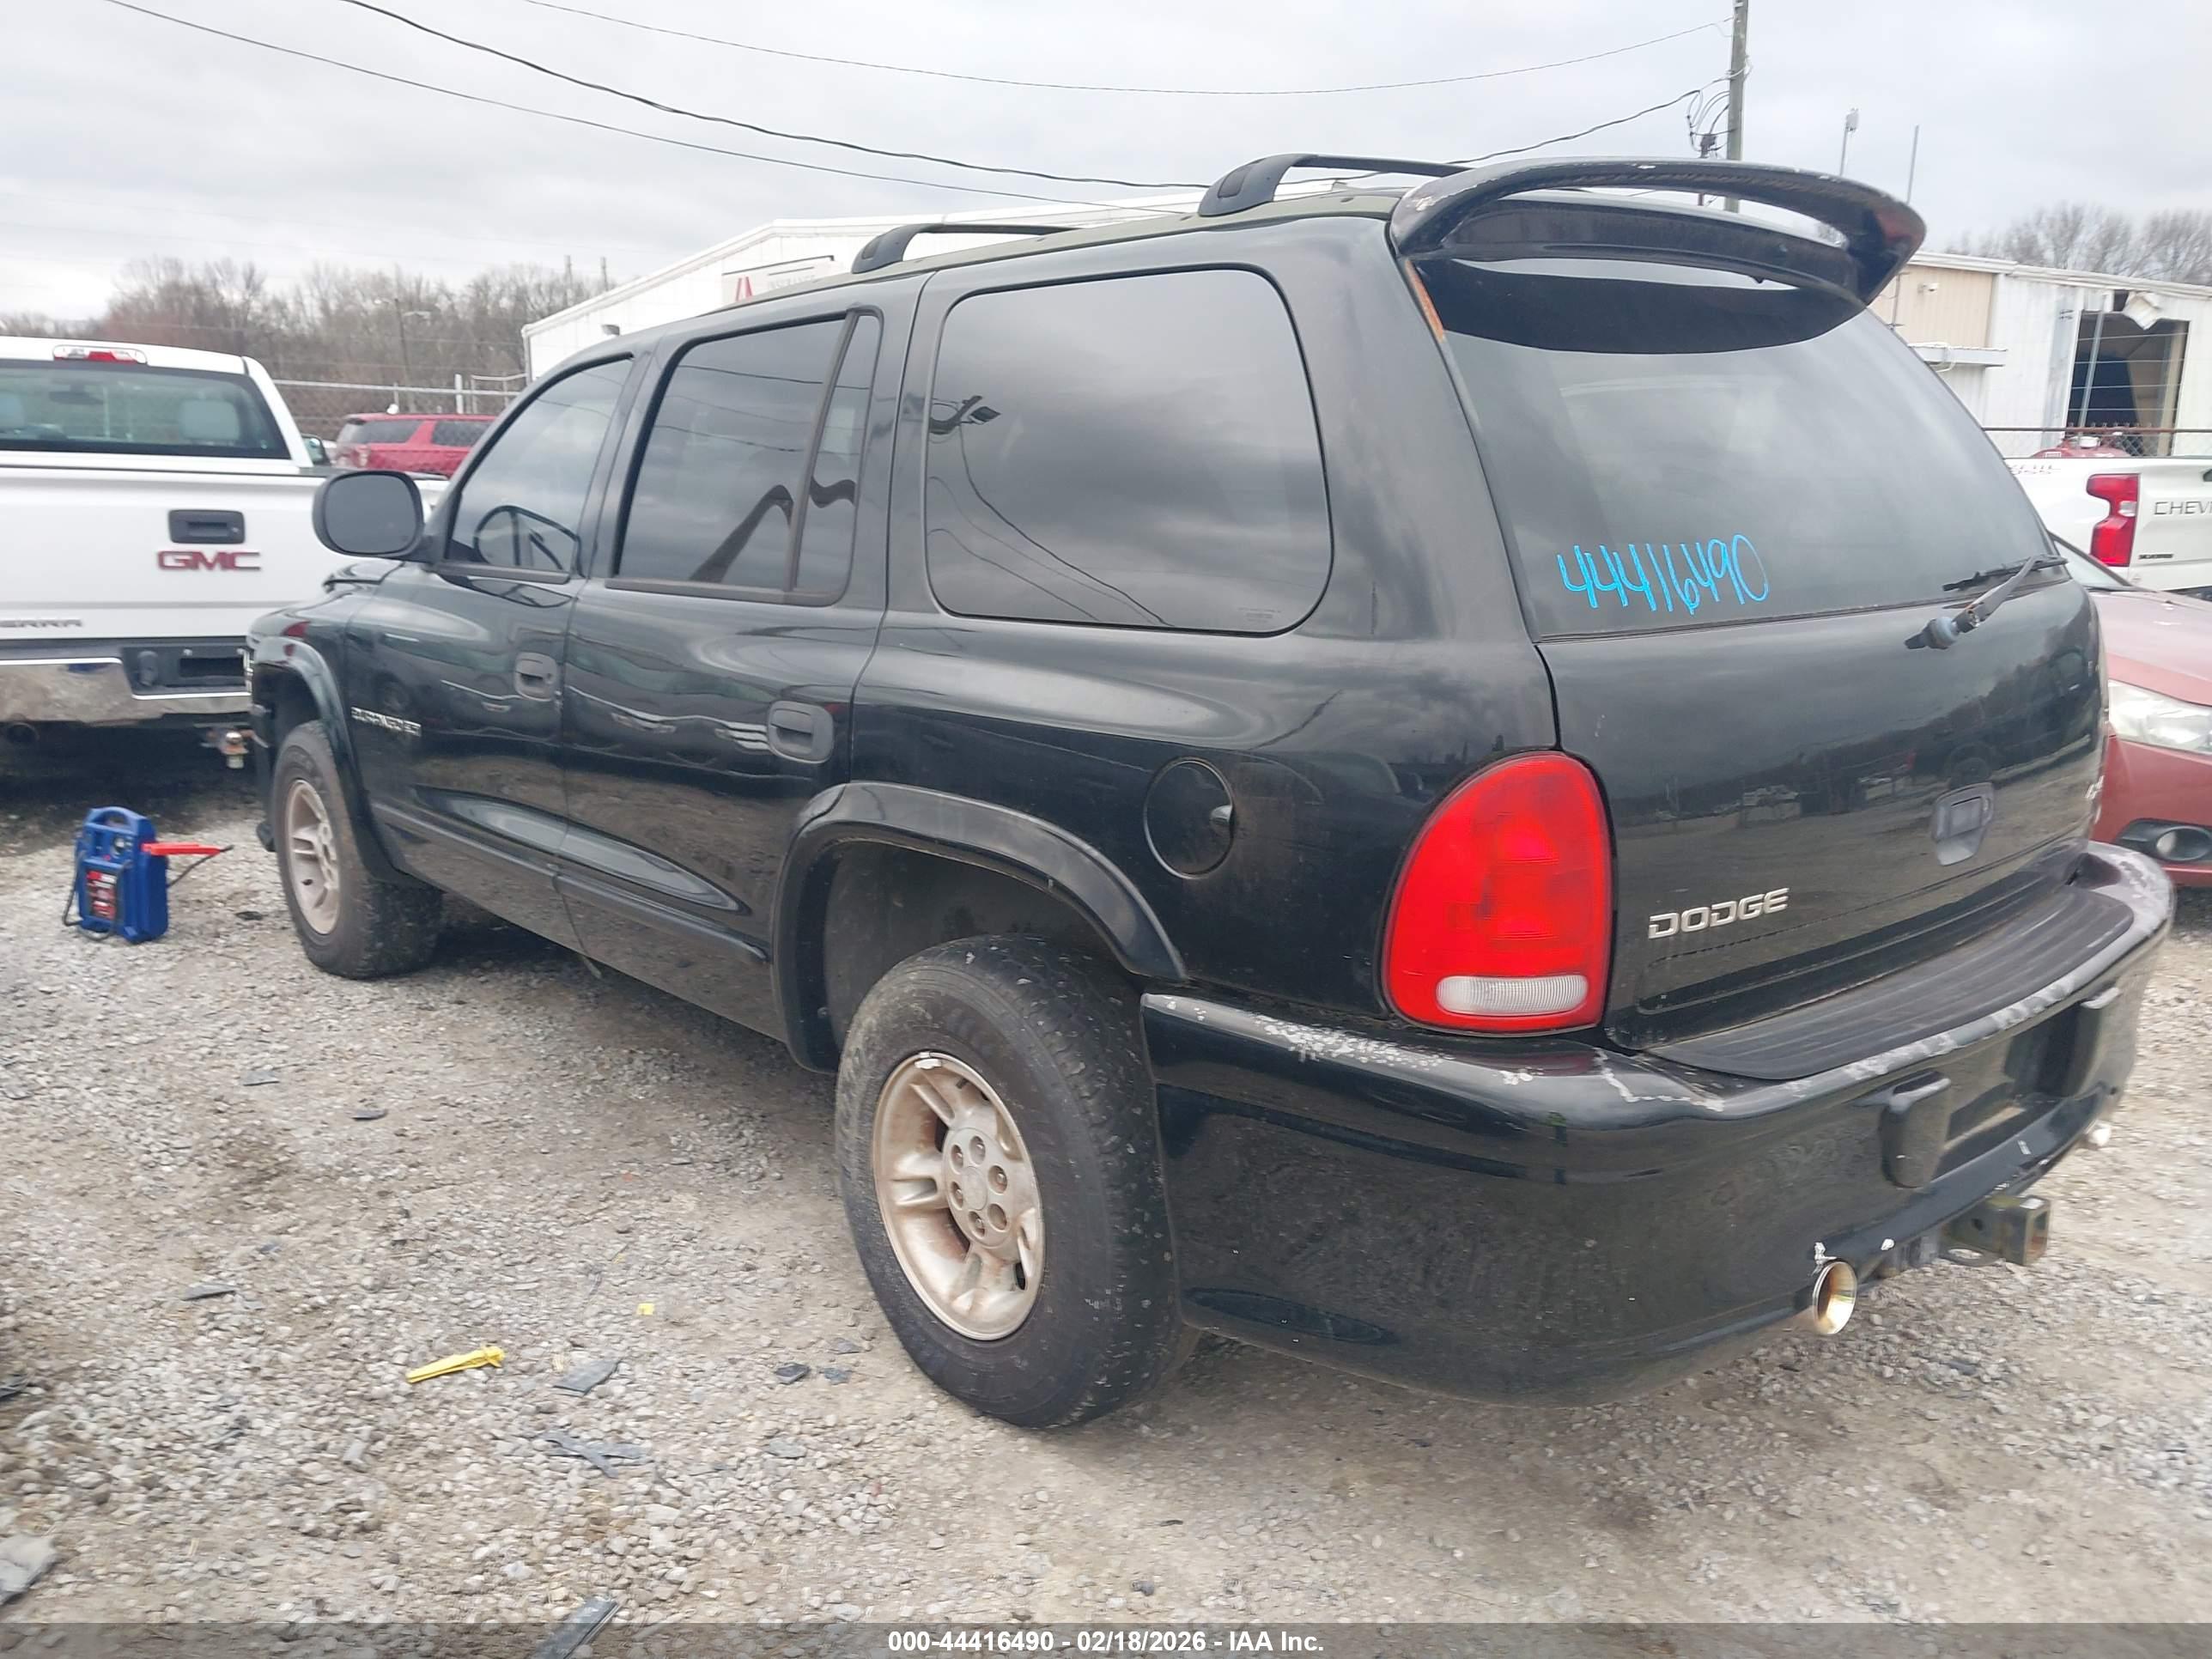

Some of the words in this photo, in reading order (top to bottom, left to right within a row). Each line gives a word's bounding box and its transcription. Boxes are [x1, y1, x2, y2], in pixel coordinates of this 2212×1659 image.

[2154, 501, 2212, 515] CHEV
[158, 550, 261, 570] GMC
[1556, 533, 1770, 616] 44416490
[1648, 887, 1790, 939] DODGE
